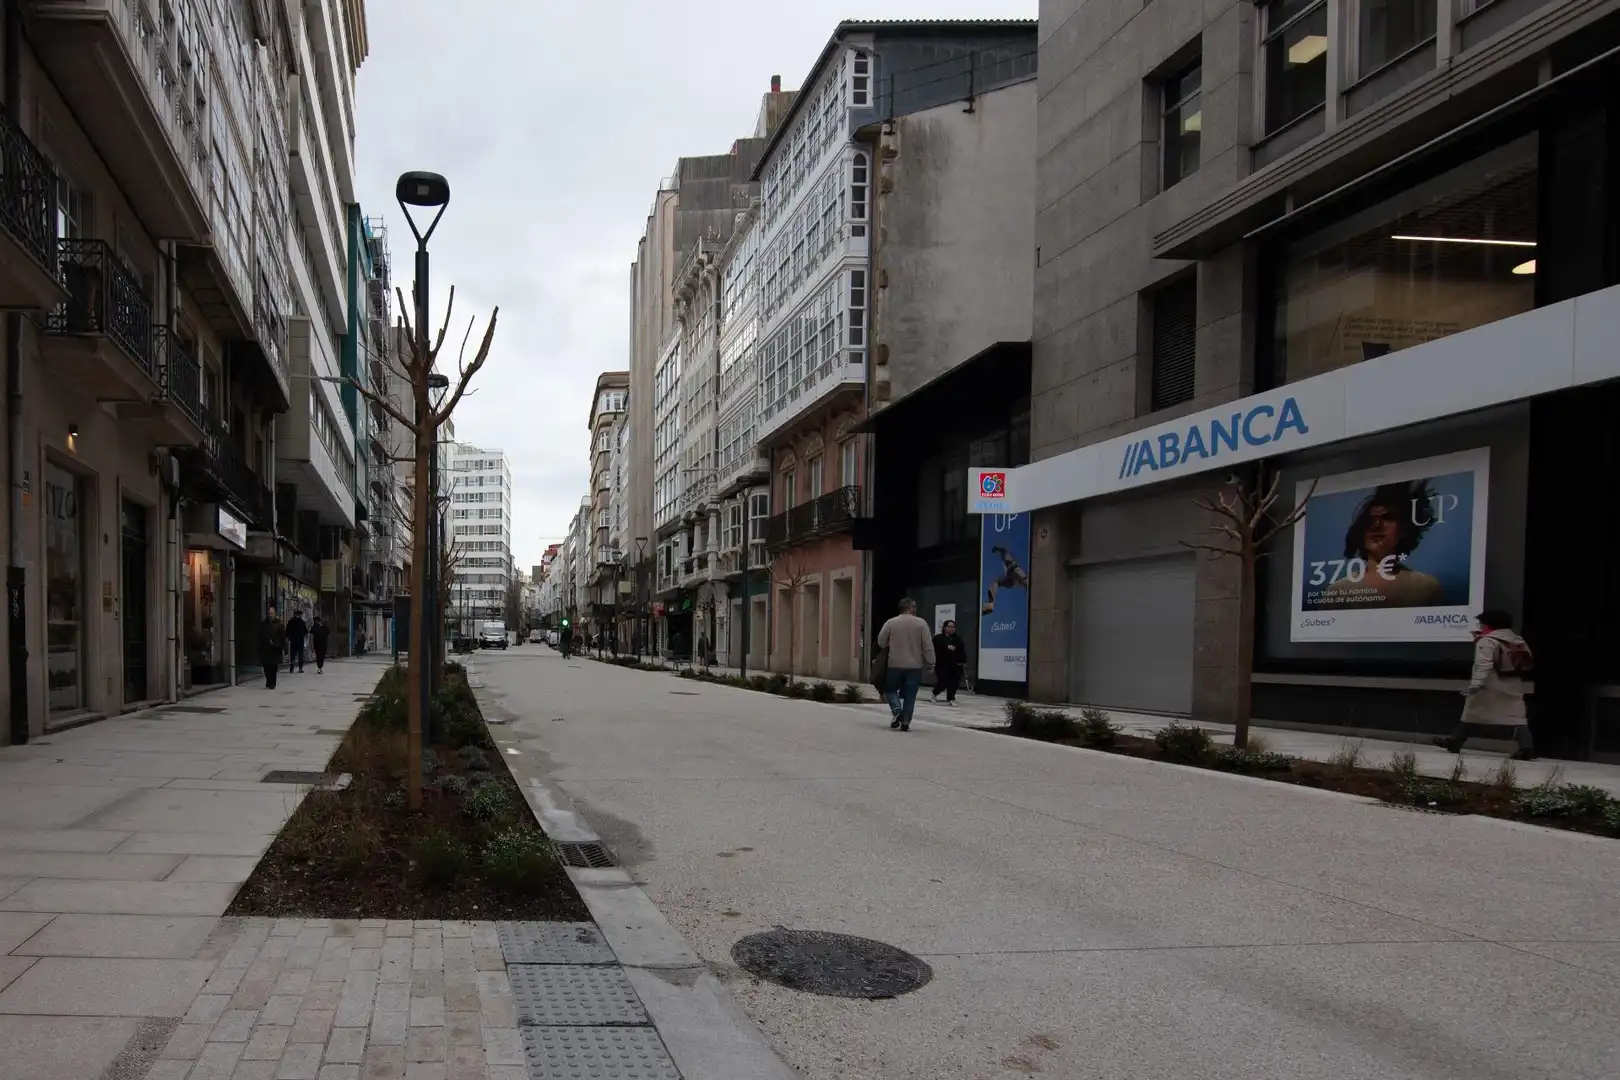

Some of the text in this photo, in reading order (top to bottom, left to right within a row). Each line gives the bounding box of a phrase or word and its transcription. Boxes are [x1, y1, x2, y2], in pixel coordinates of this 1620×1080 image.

[1411, 494, 1458, 527] UP
[1309, 559, 1366, 586] 370
[1300, 617, 1336, 629] ¿Subes?
